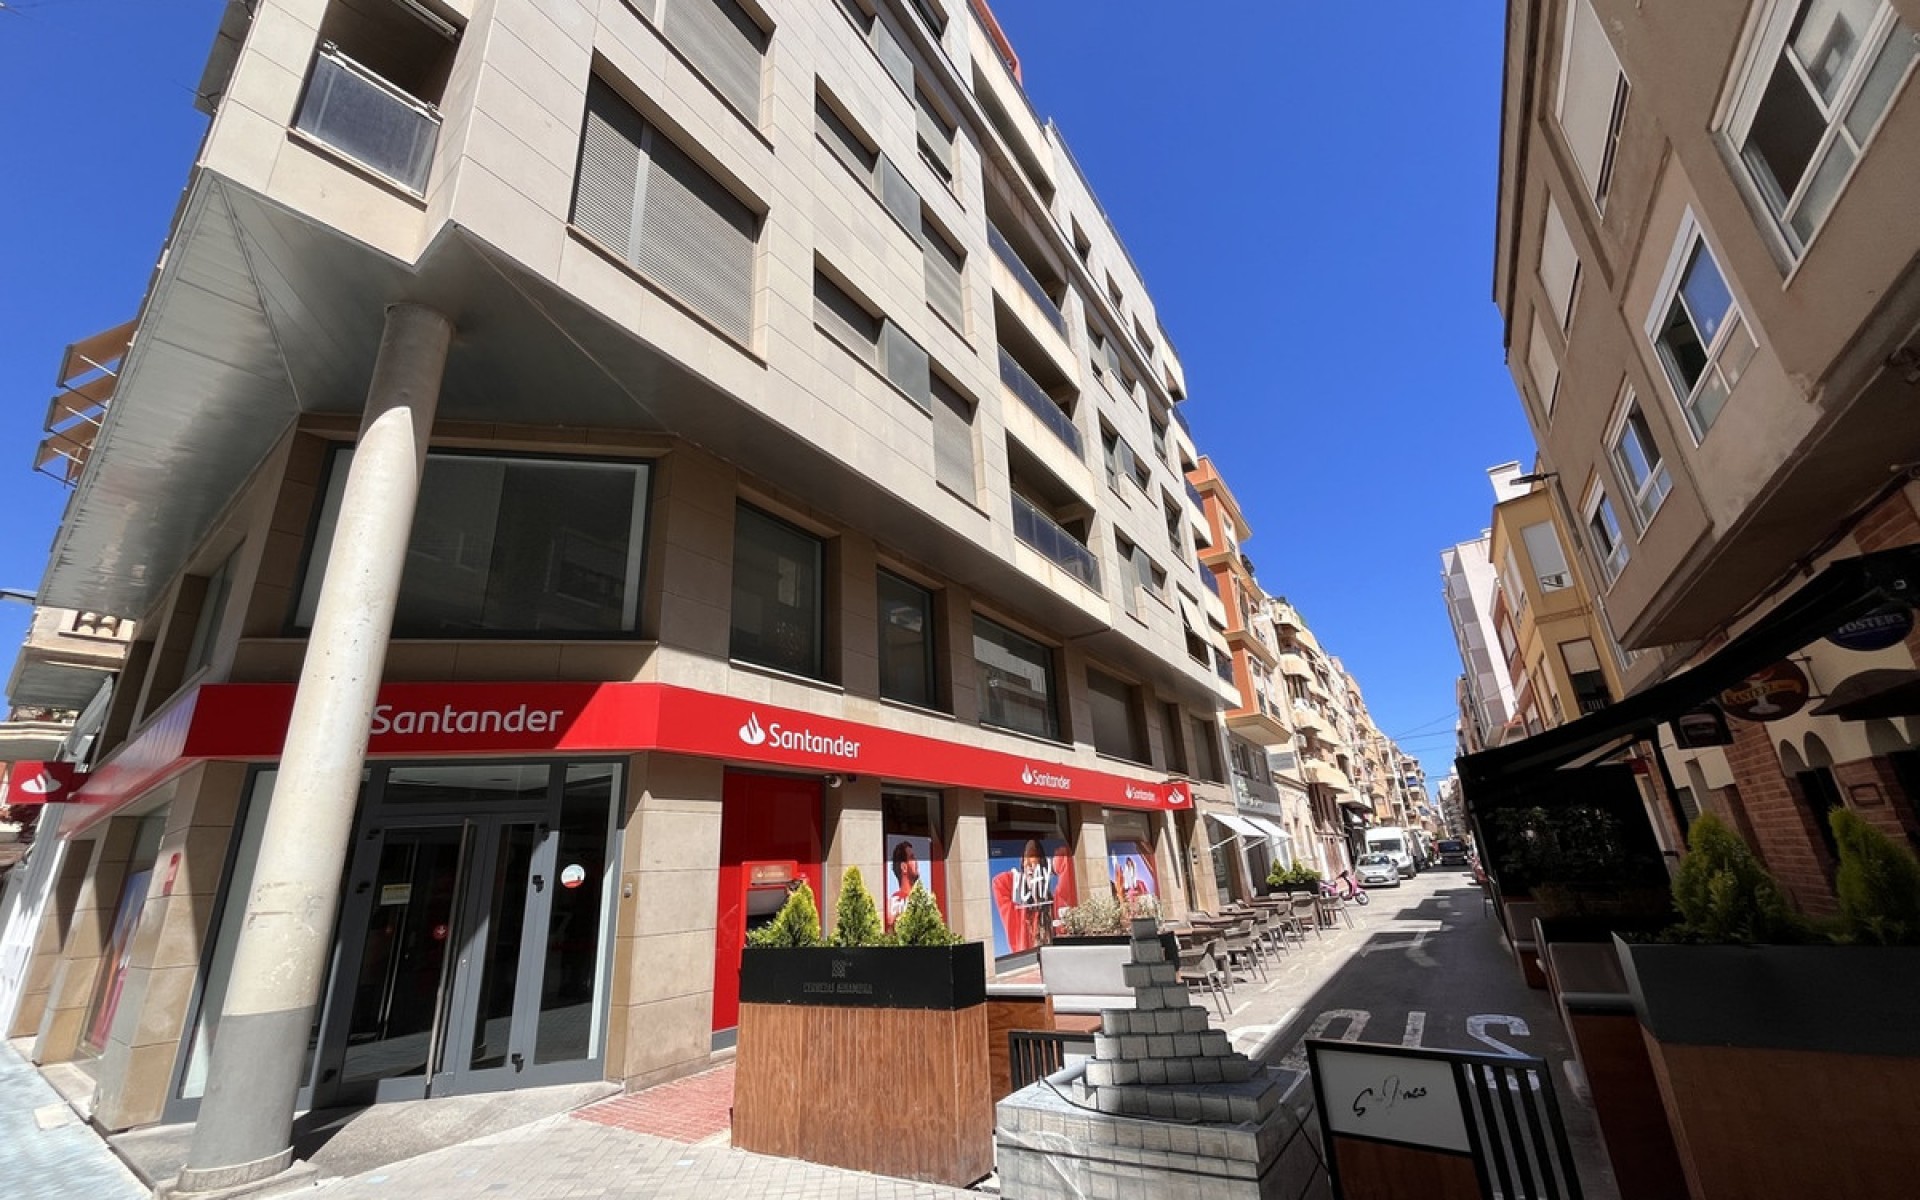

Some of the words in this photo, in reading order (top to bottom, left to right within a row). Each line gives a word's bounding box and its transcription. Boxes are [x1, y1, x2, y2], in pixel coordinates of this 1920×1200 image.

[370, 703, 564, 735] Santander
[768, 722, 861, 759] Santander
[1032, 769, 1071, 789] Santander
[1010, 857, 1052, 902] PLAY
